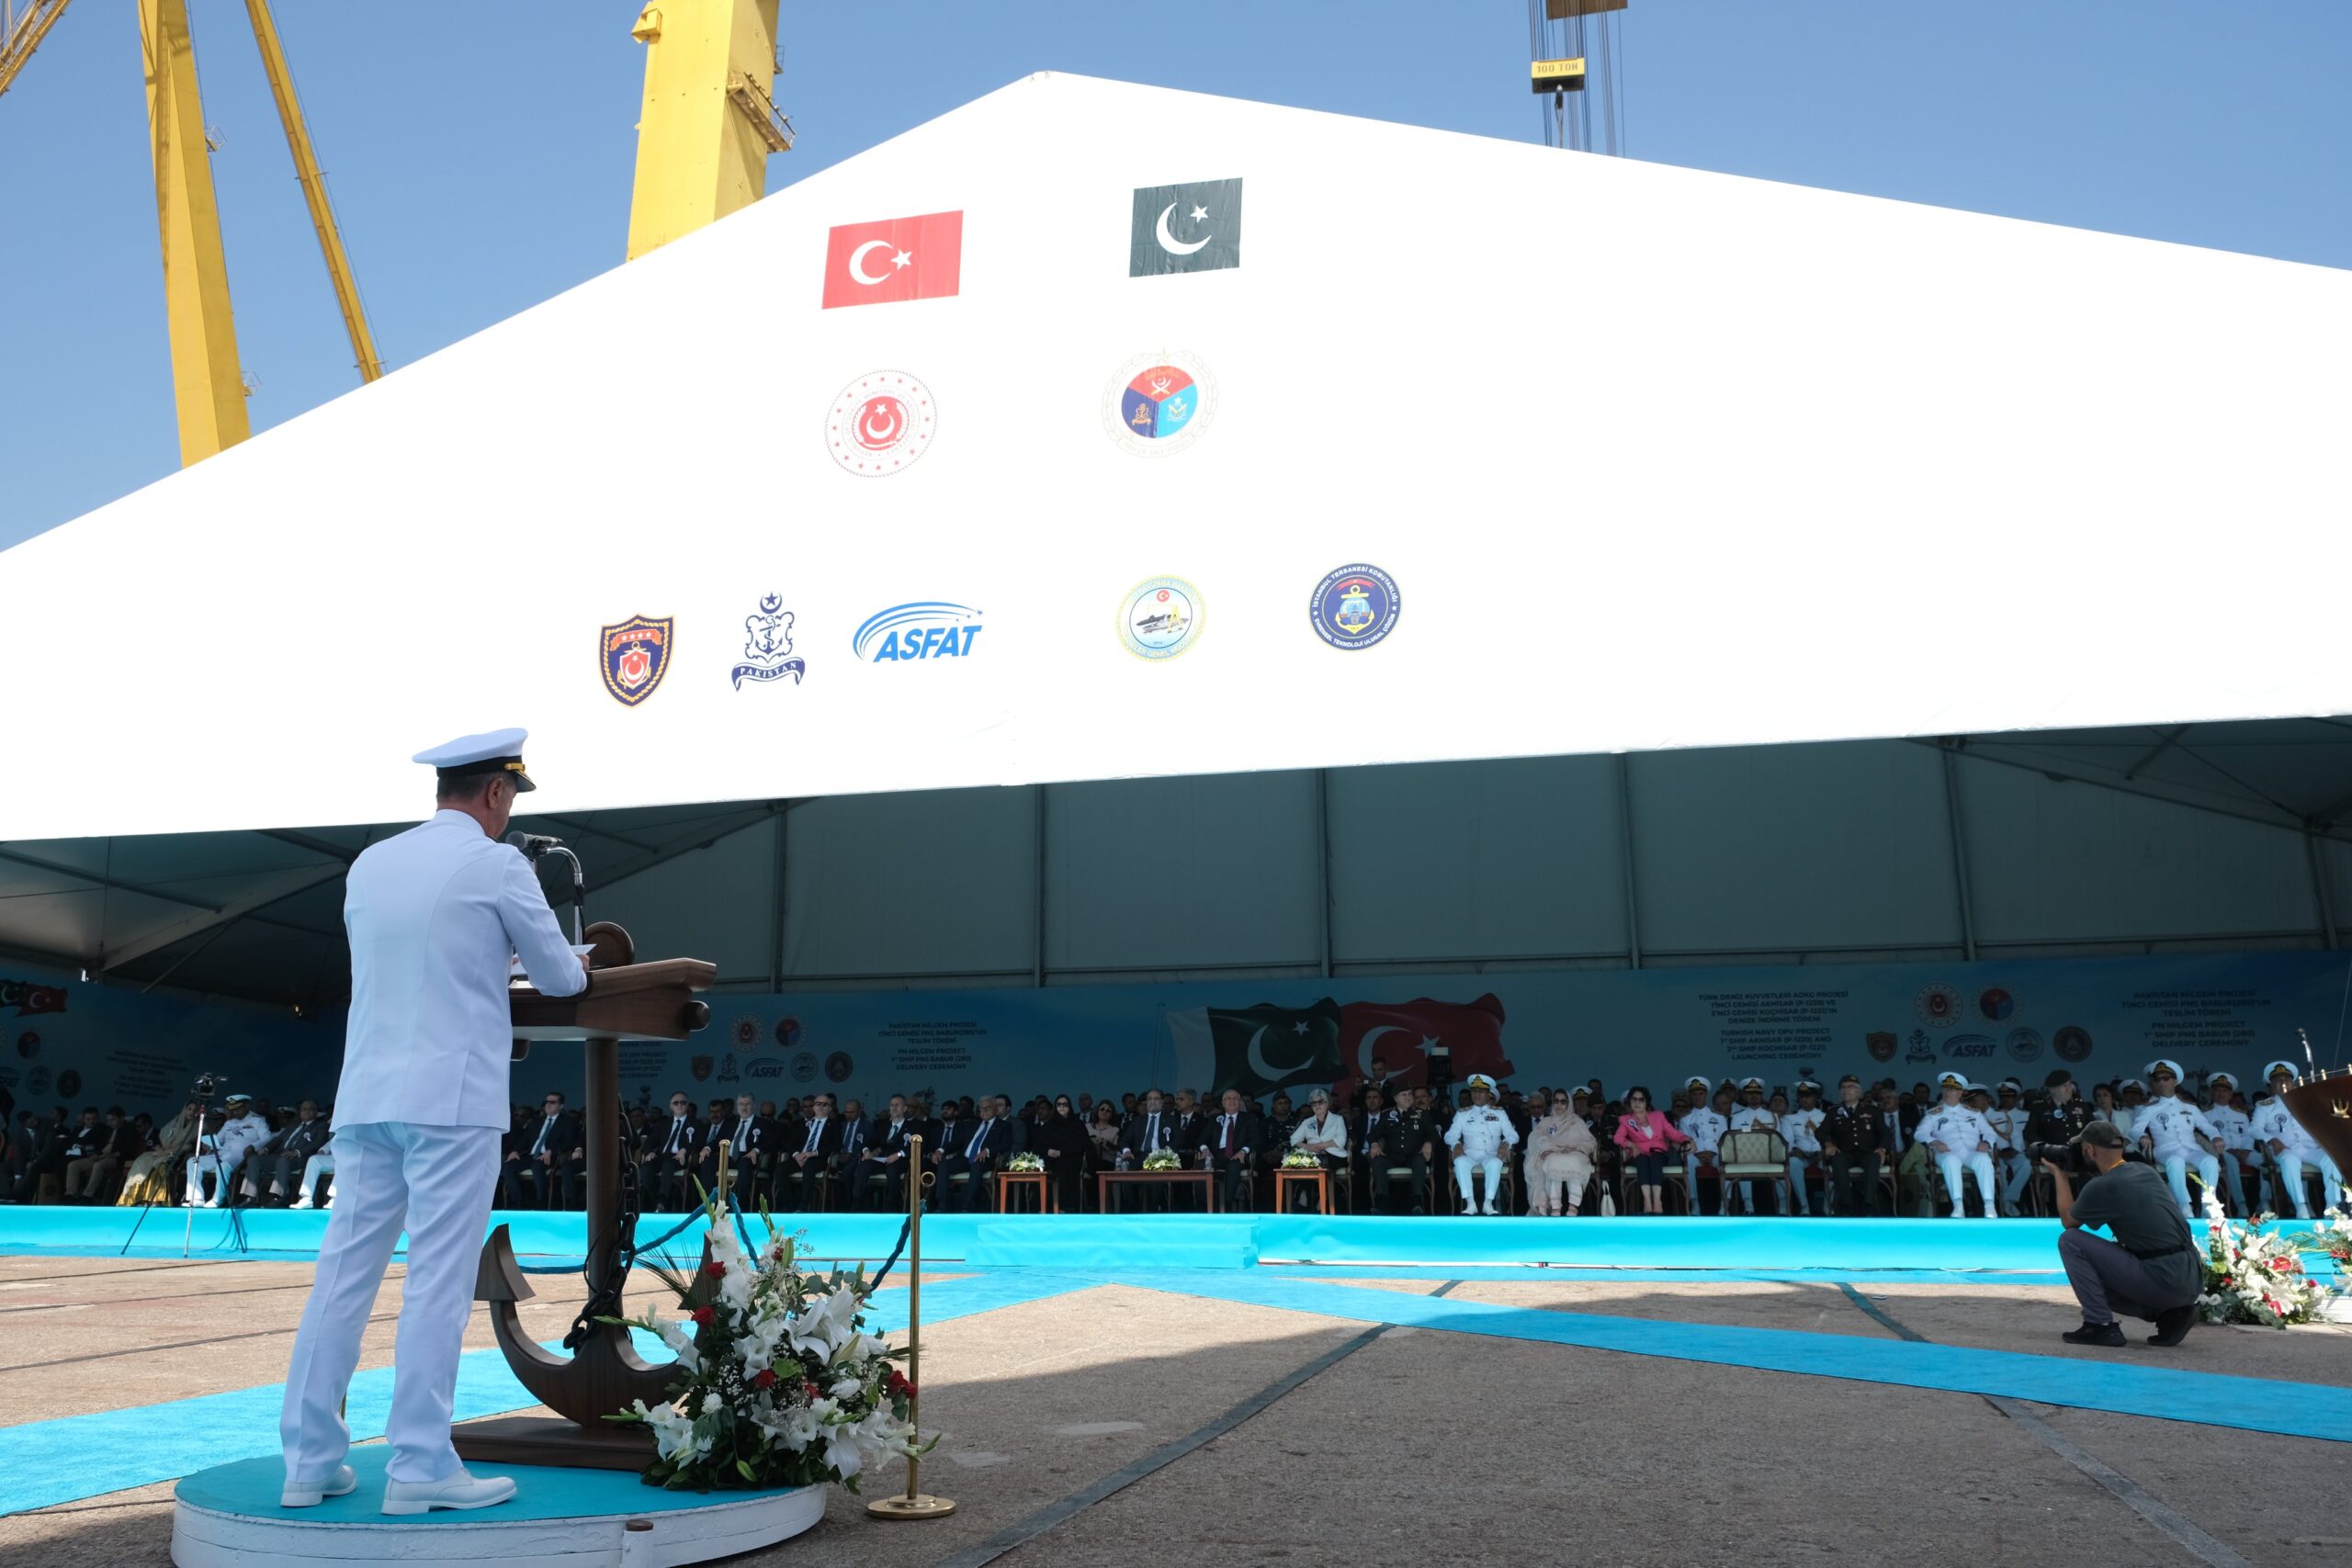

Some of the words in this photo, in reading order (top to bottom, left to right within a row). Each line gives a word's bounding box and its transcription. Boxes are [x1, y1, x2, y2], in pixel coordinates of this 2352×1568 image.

[1537, 64, 1555, 73] 100
[1557, 62, 1578, 72] TON
[872, 625, 983, 663] ASFAT
[740, 661, 797, 678] PAKISTAN
[2204, 1020, 2245, 1028] PROJECT
[2152, 1040, 2197, 1048] DELIVERY
[1951, 1043, 1996, 1058] ASFAT
[751, 1066, 785, 1078] ASFAT
